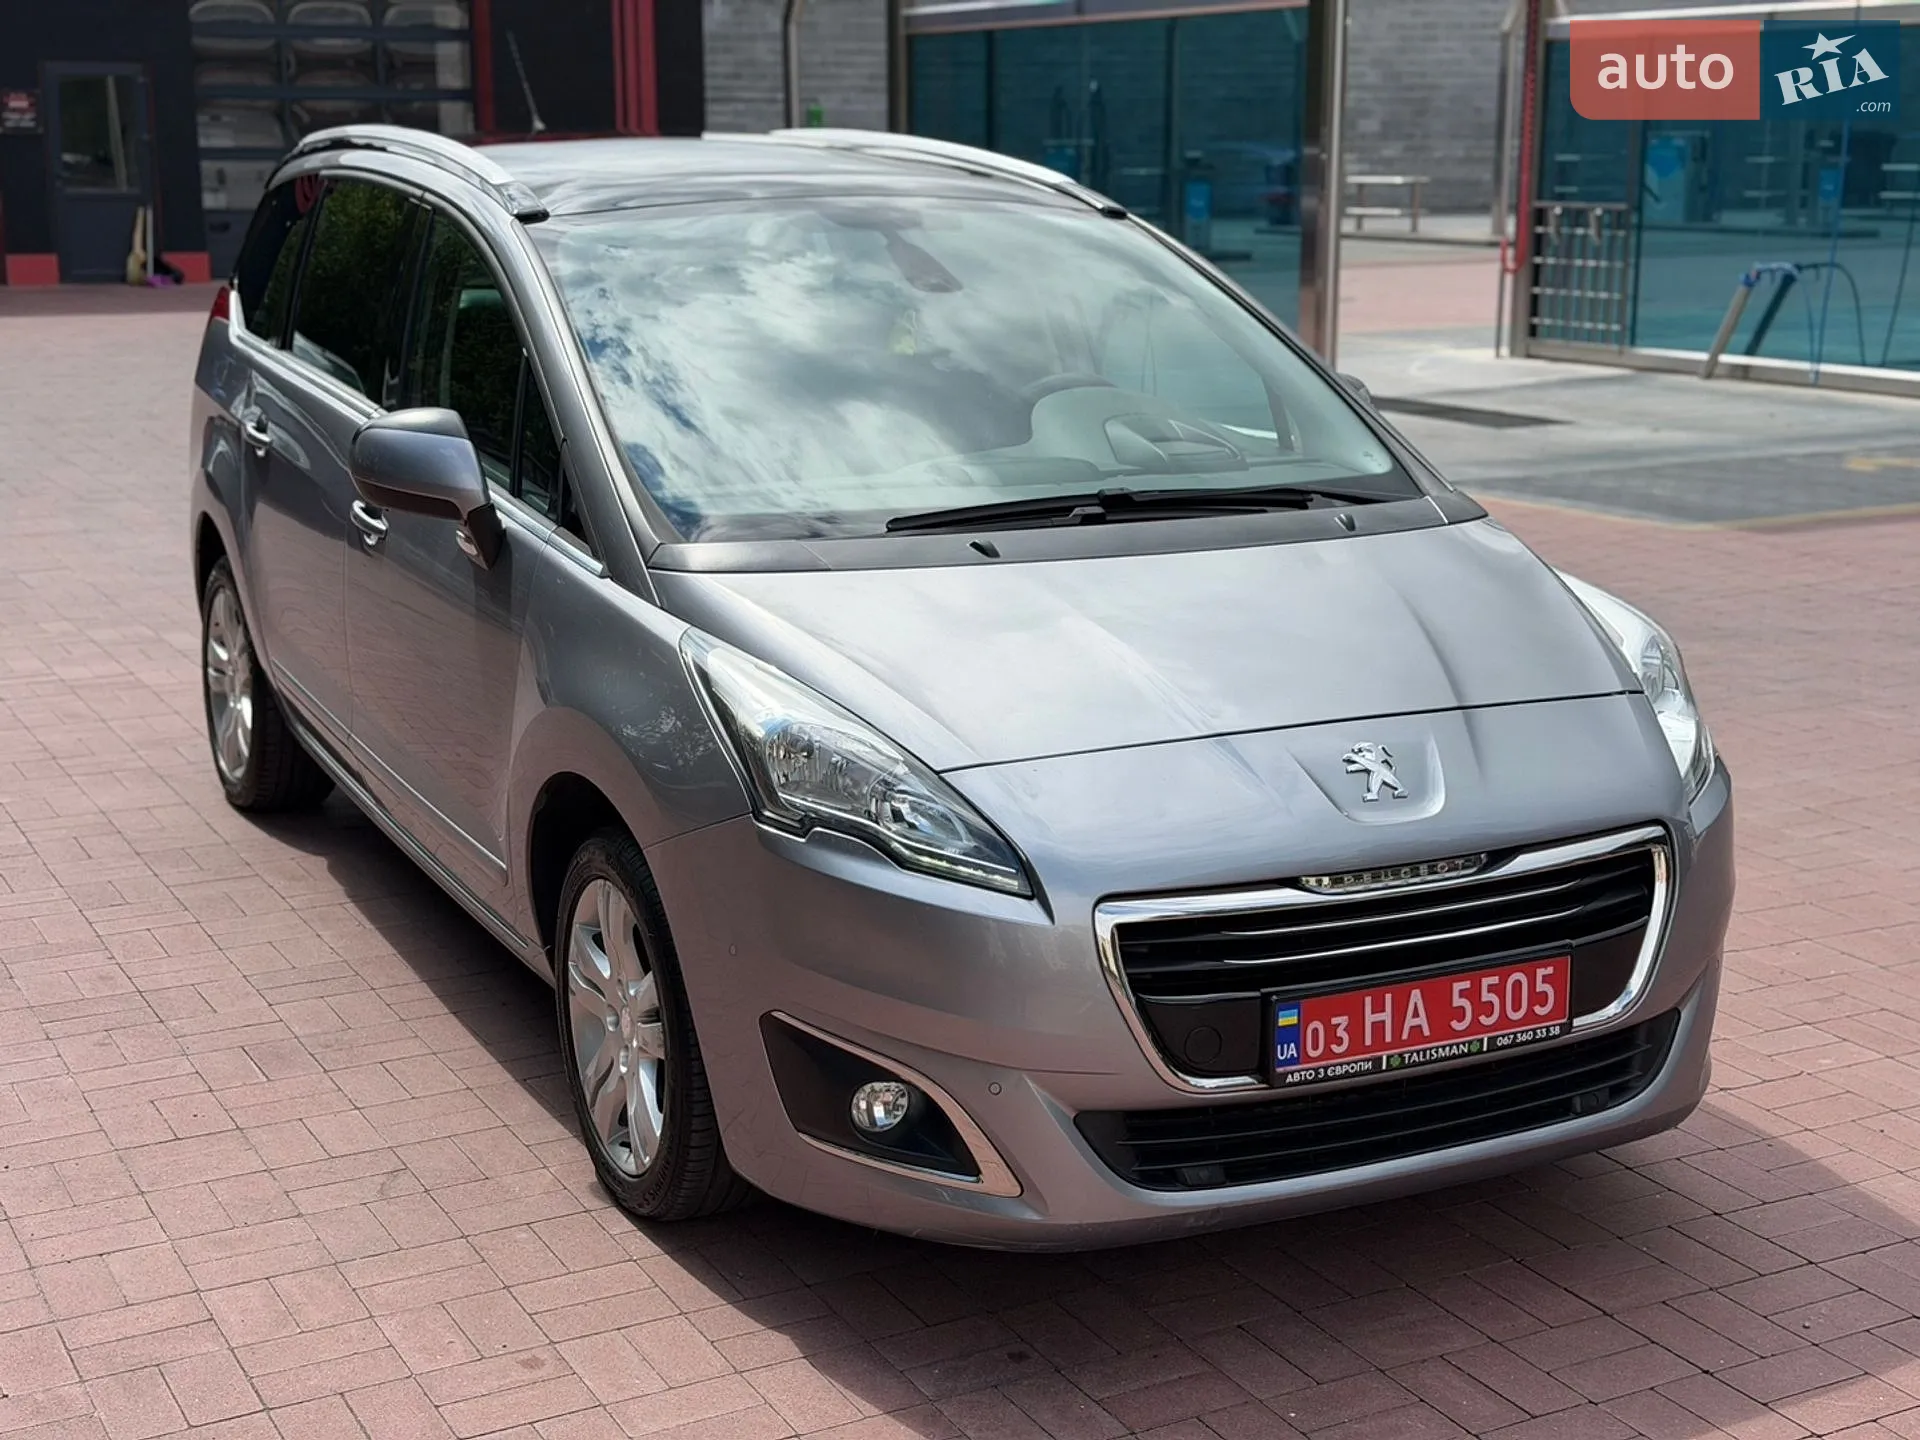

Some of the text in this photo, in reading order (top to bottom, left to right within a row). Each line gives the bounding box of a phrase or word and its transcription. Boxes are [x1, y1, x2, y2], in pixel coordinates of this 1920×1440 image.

[1305, 966, 1556, 1058] 03 HA 5505
[1495, 1024, 1561, 1047] 067 360 33 38
[1276, 1042, 1298, 1060] UA
[1403, 1042, 1469, 1065] TALISMAN
[1285, 1069, 1316, 1083] АВТО
[1327, 1060, 1373, 1077] ЄВРОПИ
